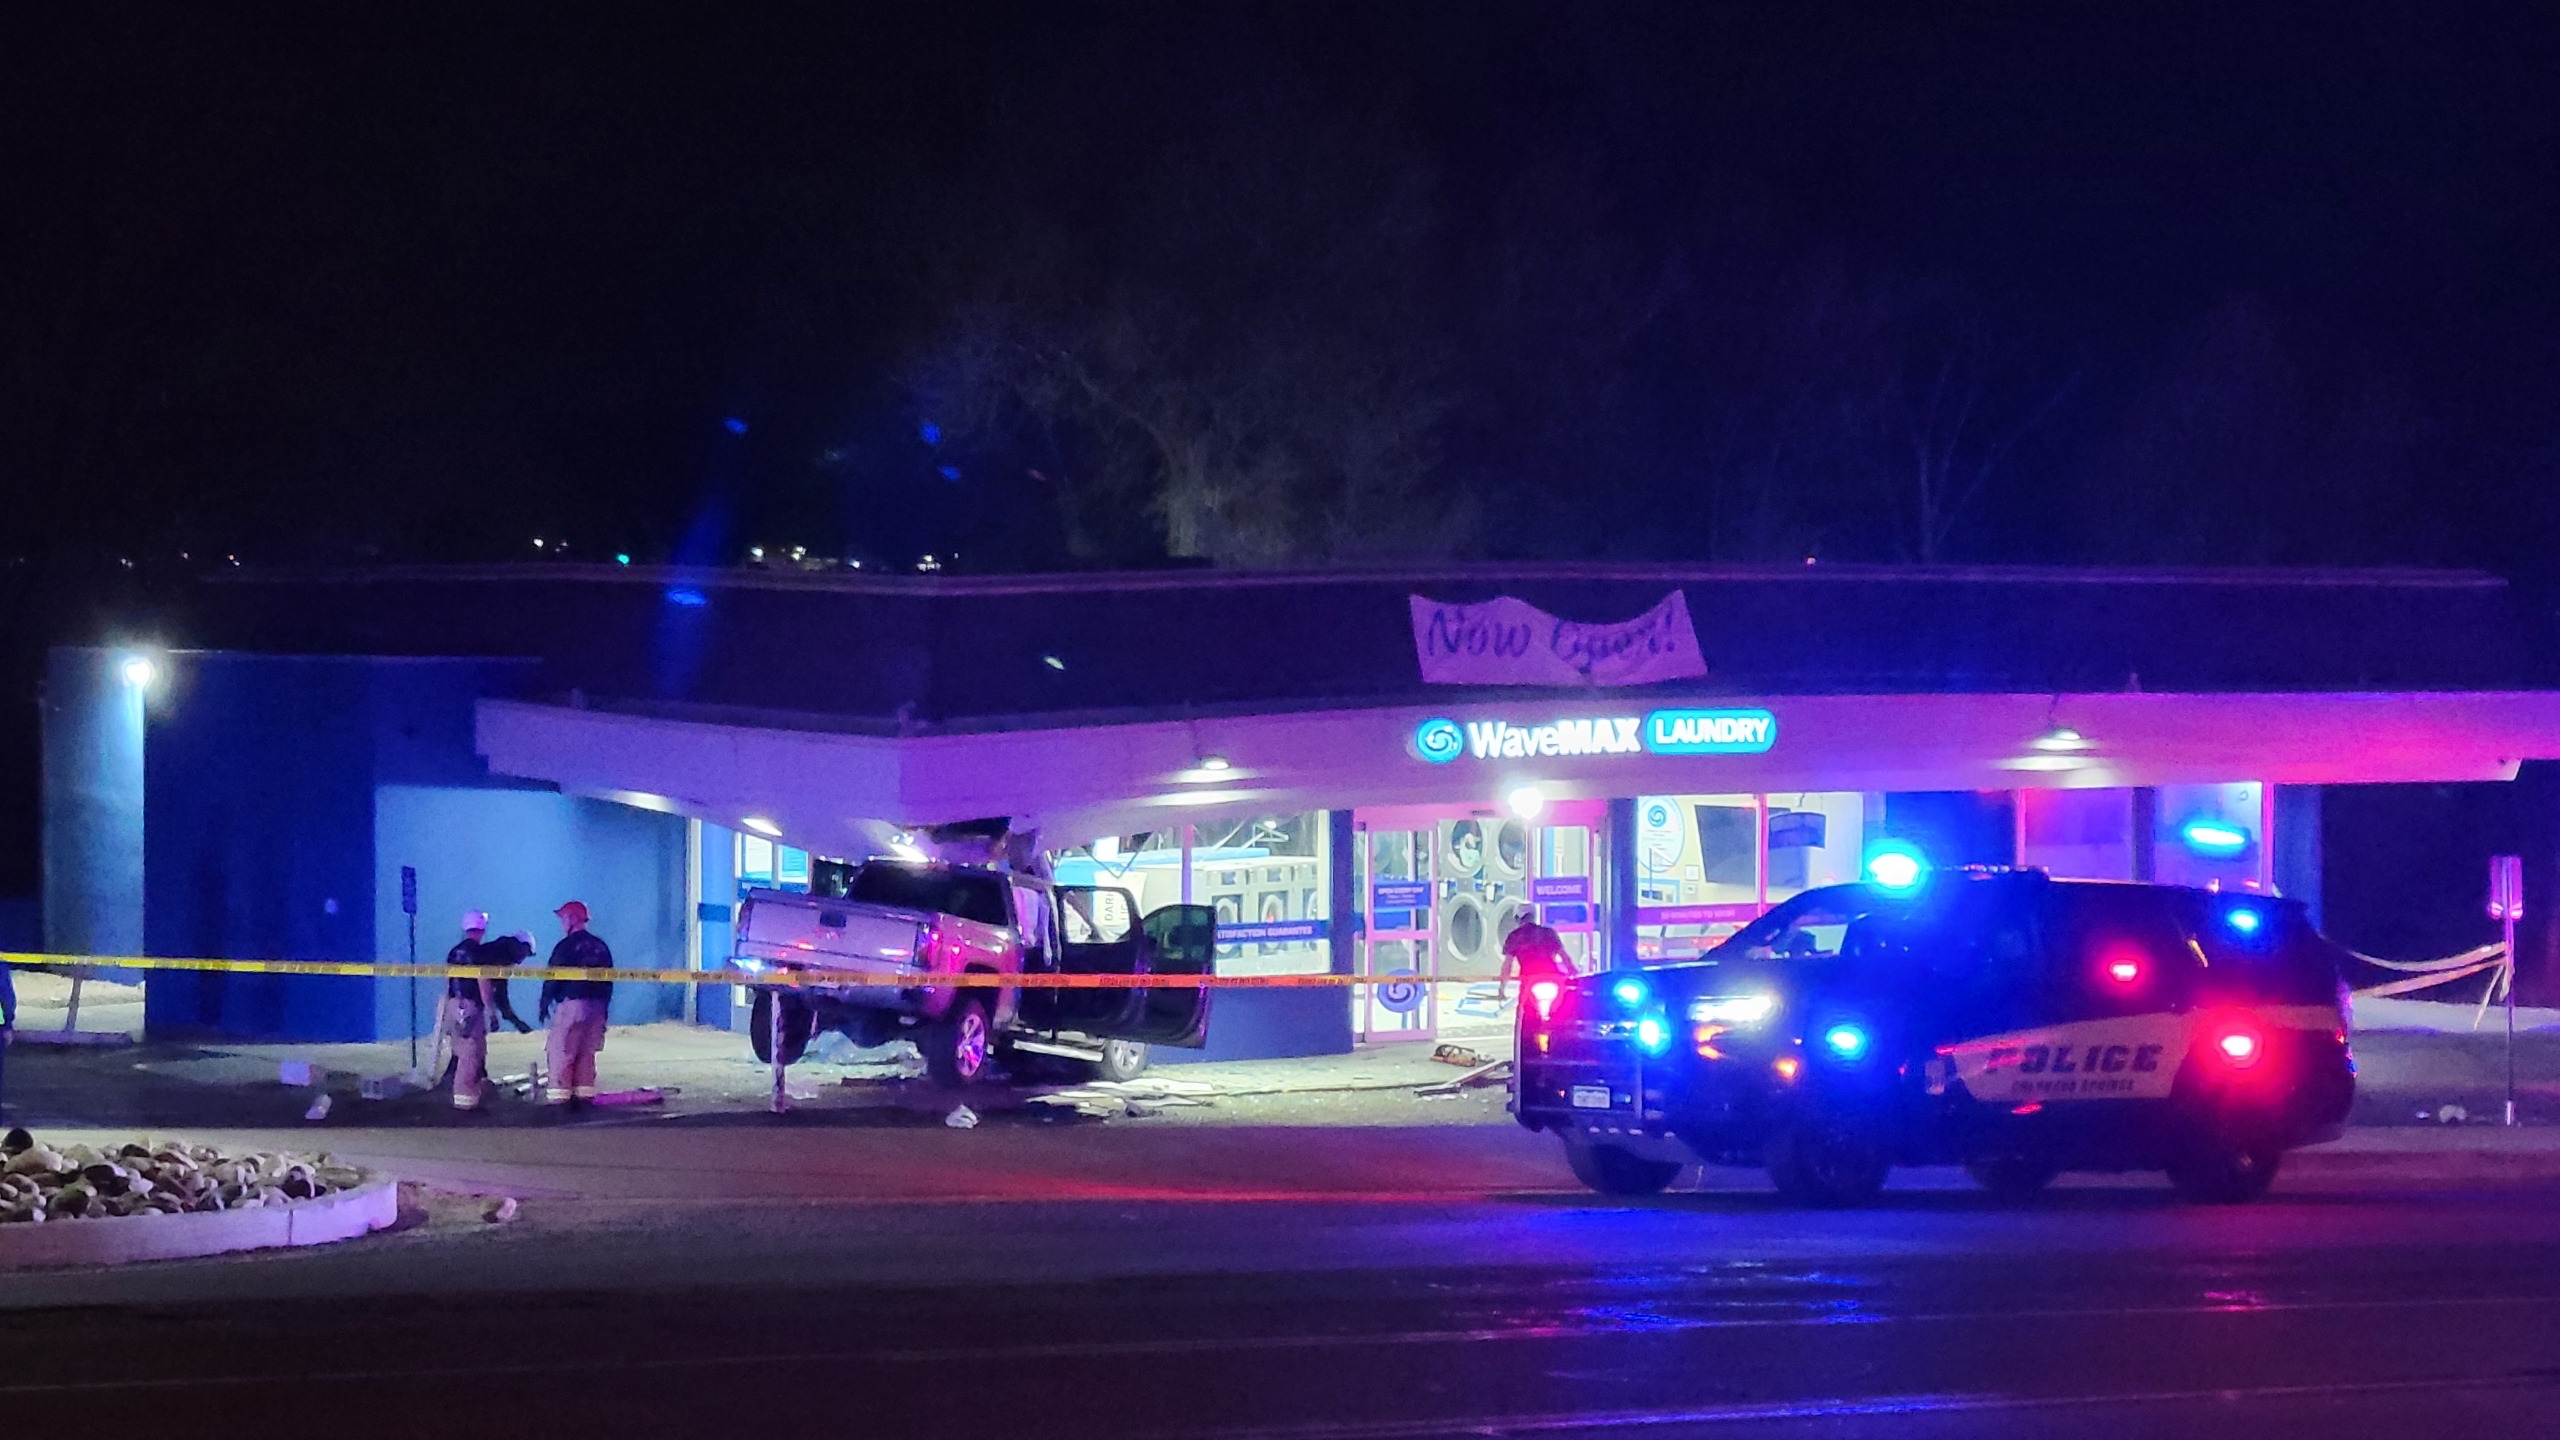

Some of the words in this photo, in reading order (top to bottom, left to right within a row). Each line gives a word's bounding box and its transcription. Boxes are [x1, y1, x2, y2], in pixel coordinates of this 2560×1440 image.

[1428, 609, 1531, 658] Now
[1551, 601, 1675, 673] Open!
[1468, 717, 1642, 759] WaveMAX
[1656, 717, 1770, 745] LAUNDRY
[1536, 884, 1582, 896] WELCOME
[1986, 1043, 2163, 1073] POLICE
